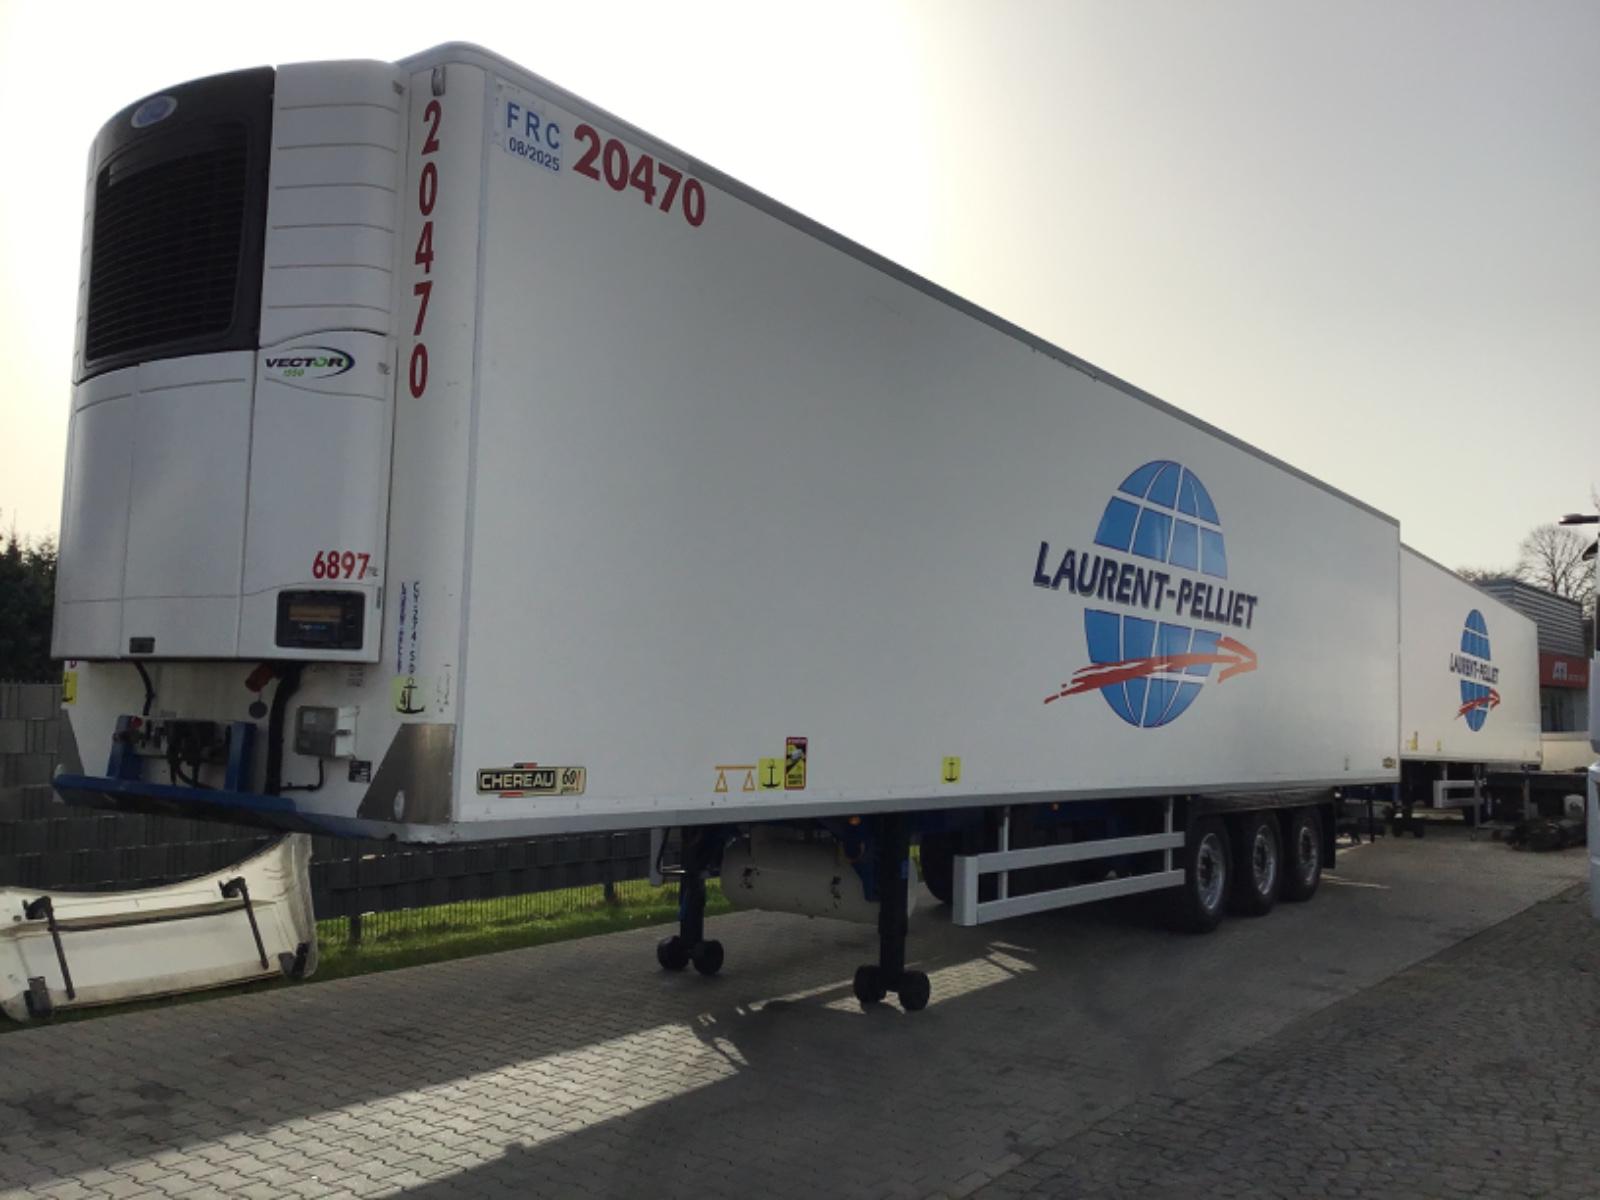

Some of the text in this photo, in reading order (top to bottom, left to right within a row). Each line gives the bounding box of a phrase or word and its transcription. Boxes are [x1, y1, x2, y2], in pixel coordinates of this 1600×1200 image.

[509, 136, 560, 171] 08/2025
[573, 123, 706, 227] 20470
[409, 100, 442, 399] 20470
[265, 357, 344, 368] VECTOR
[312, 550, 371, 580] 6897
[1033, 541, 1258, 629] LAURENT-PELLIET
[481, 771, 554, 790] CHEREAU
